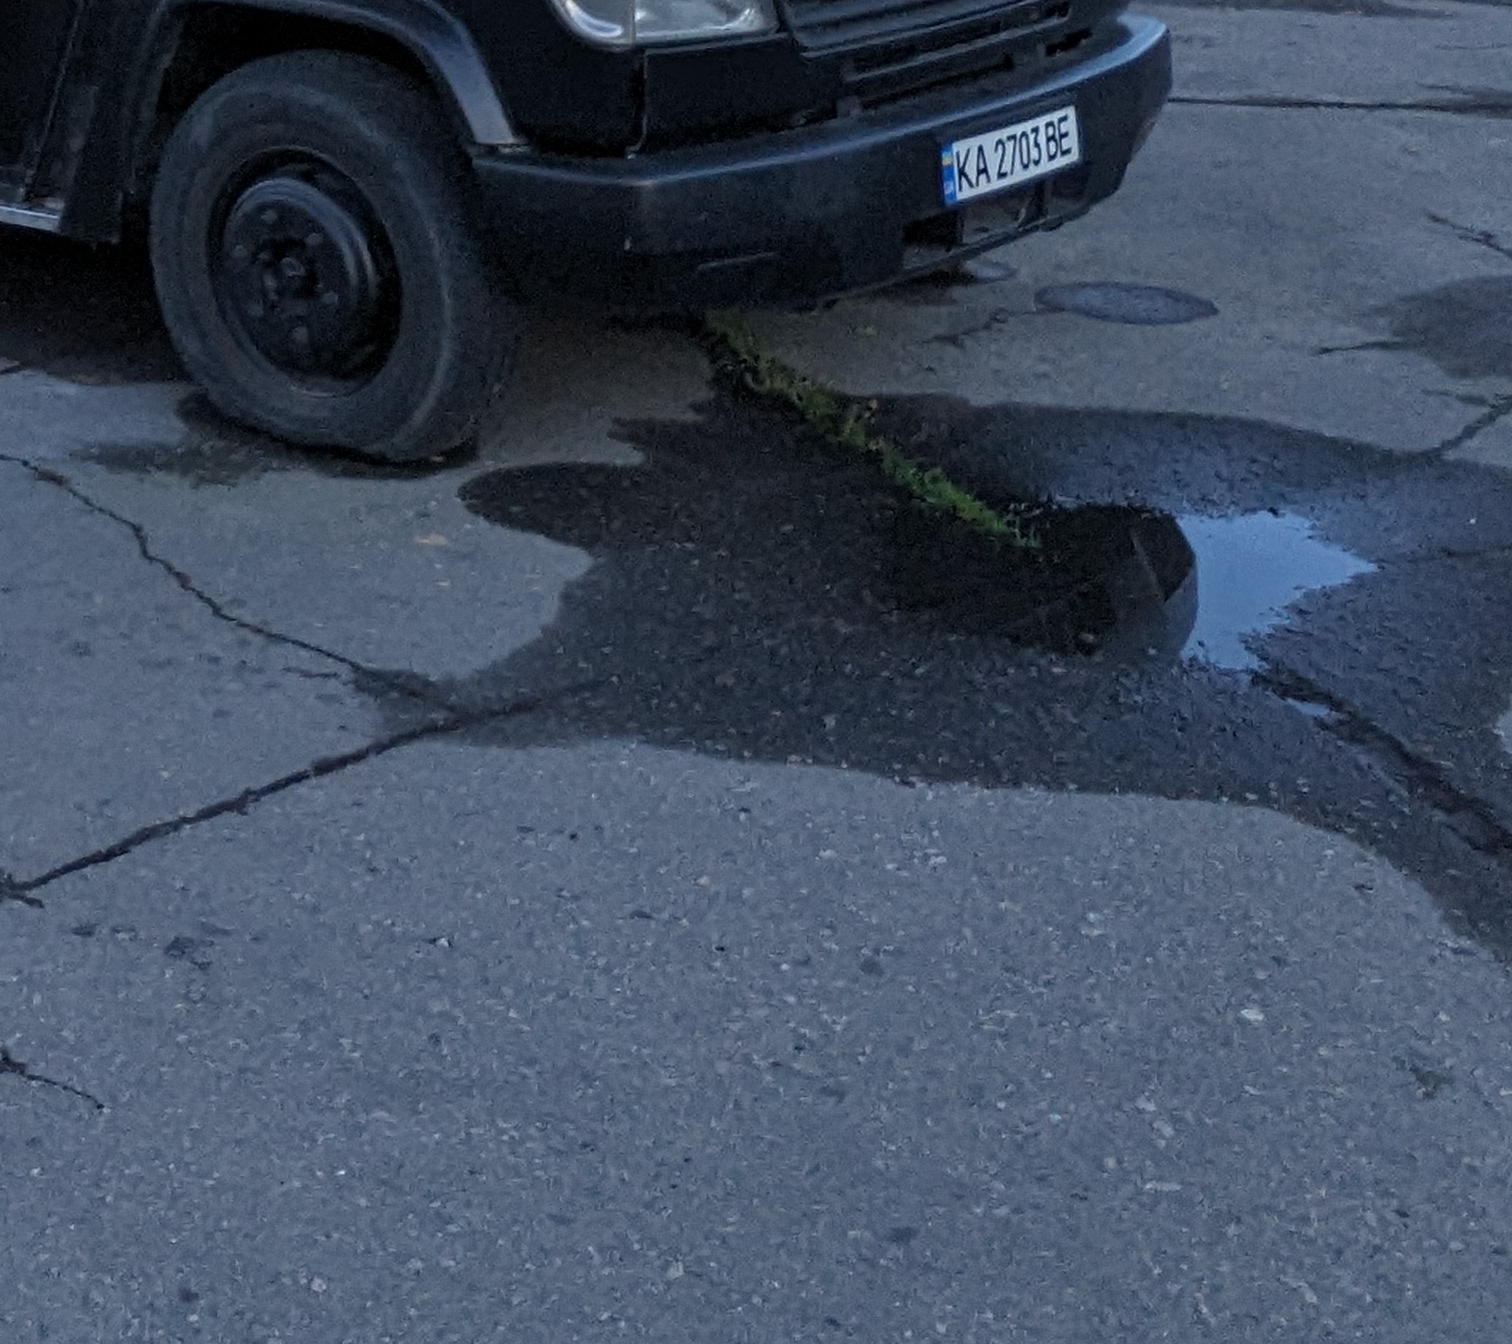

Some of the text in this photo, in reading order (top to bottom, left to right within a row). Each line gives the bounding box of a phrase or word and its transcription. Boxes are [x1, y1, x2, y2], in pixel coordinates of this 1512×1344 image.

[955, 113, 1072, 192] KA 2703 BE
